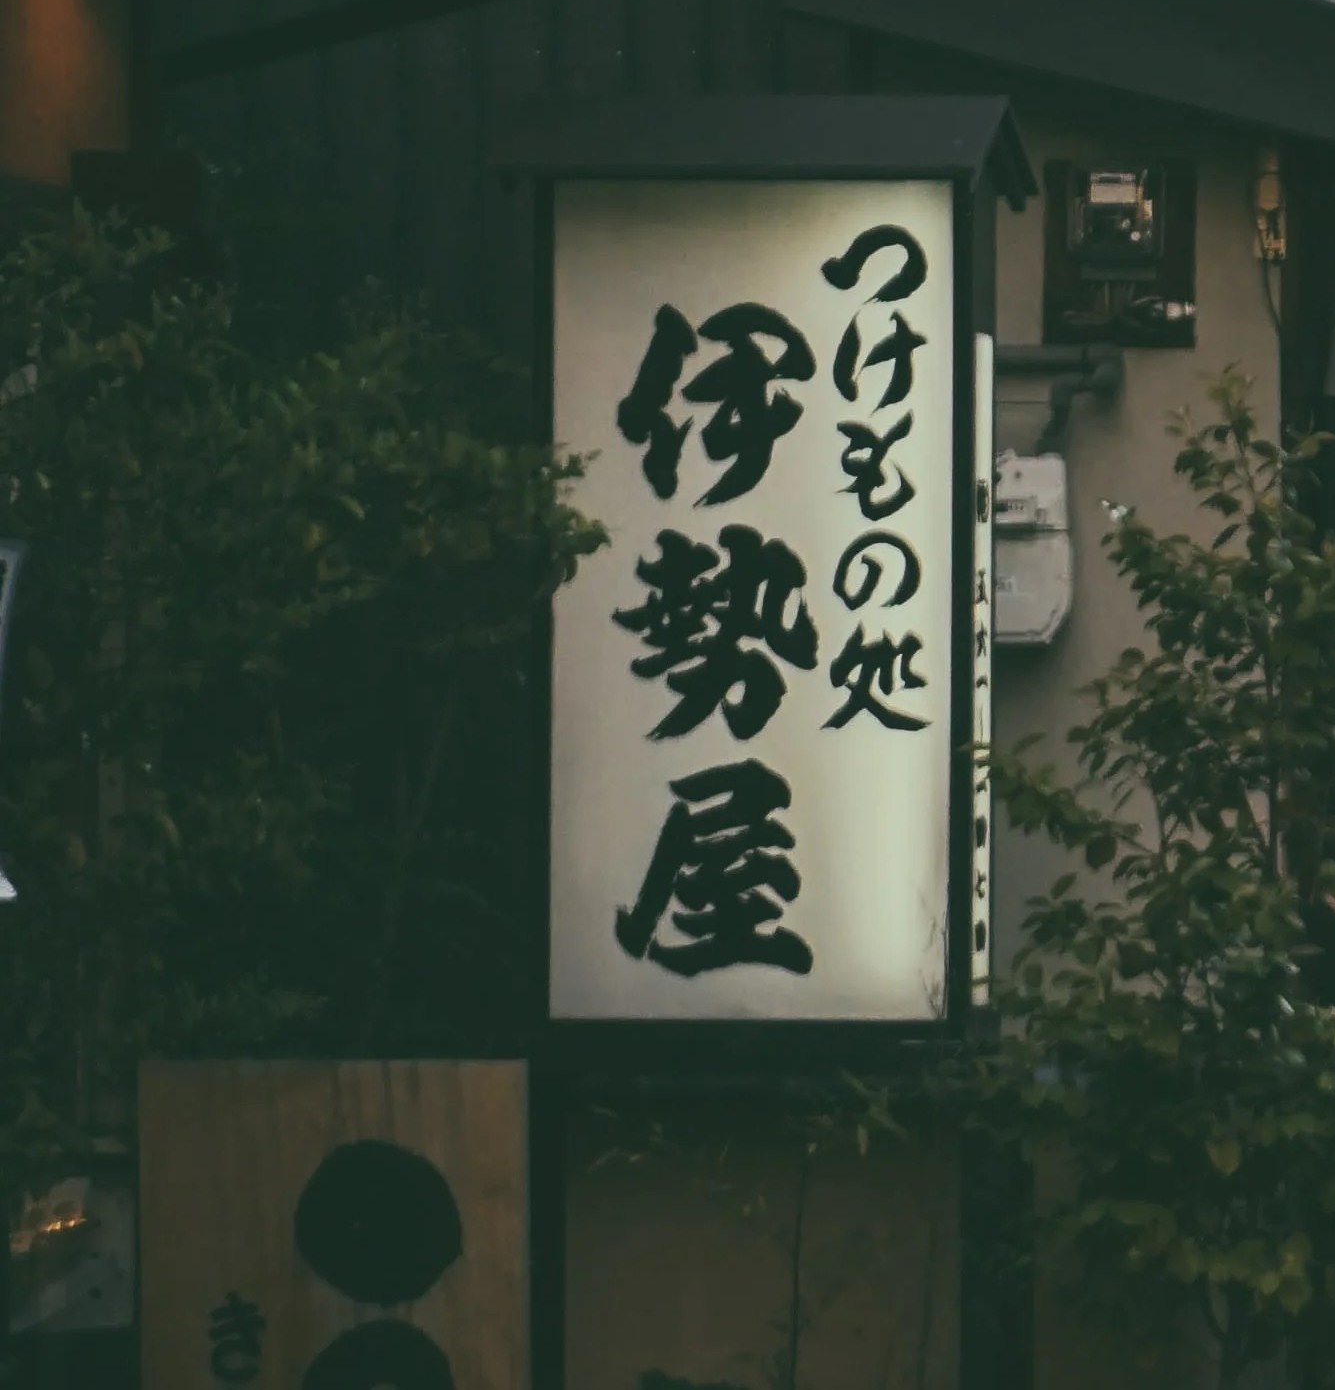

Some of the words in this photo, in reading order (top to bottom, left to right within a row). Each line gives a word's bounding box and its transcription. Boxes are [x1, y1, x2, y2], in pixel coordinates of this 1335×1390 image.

[611, 301, 819, 977] 伊勢屋
[820, 223, 933, 732] つけもの処
